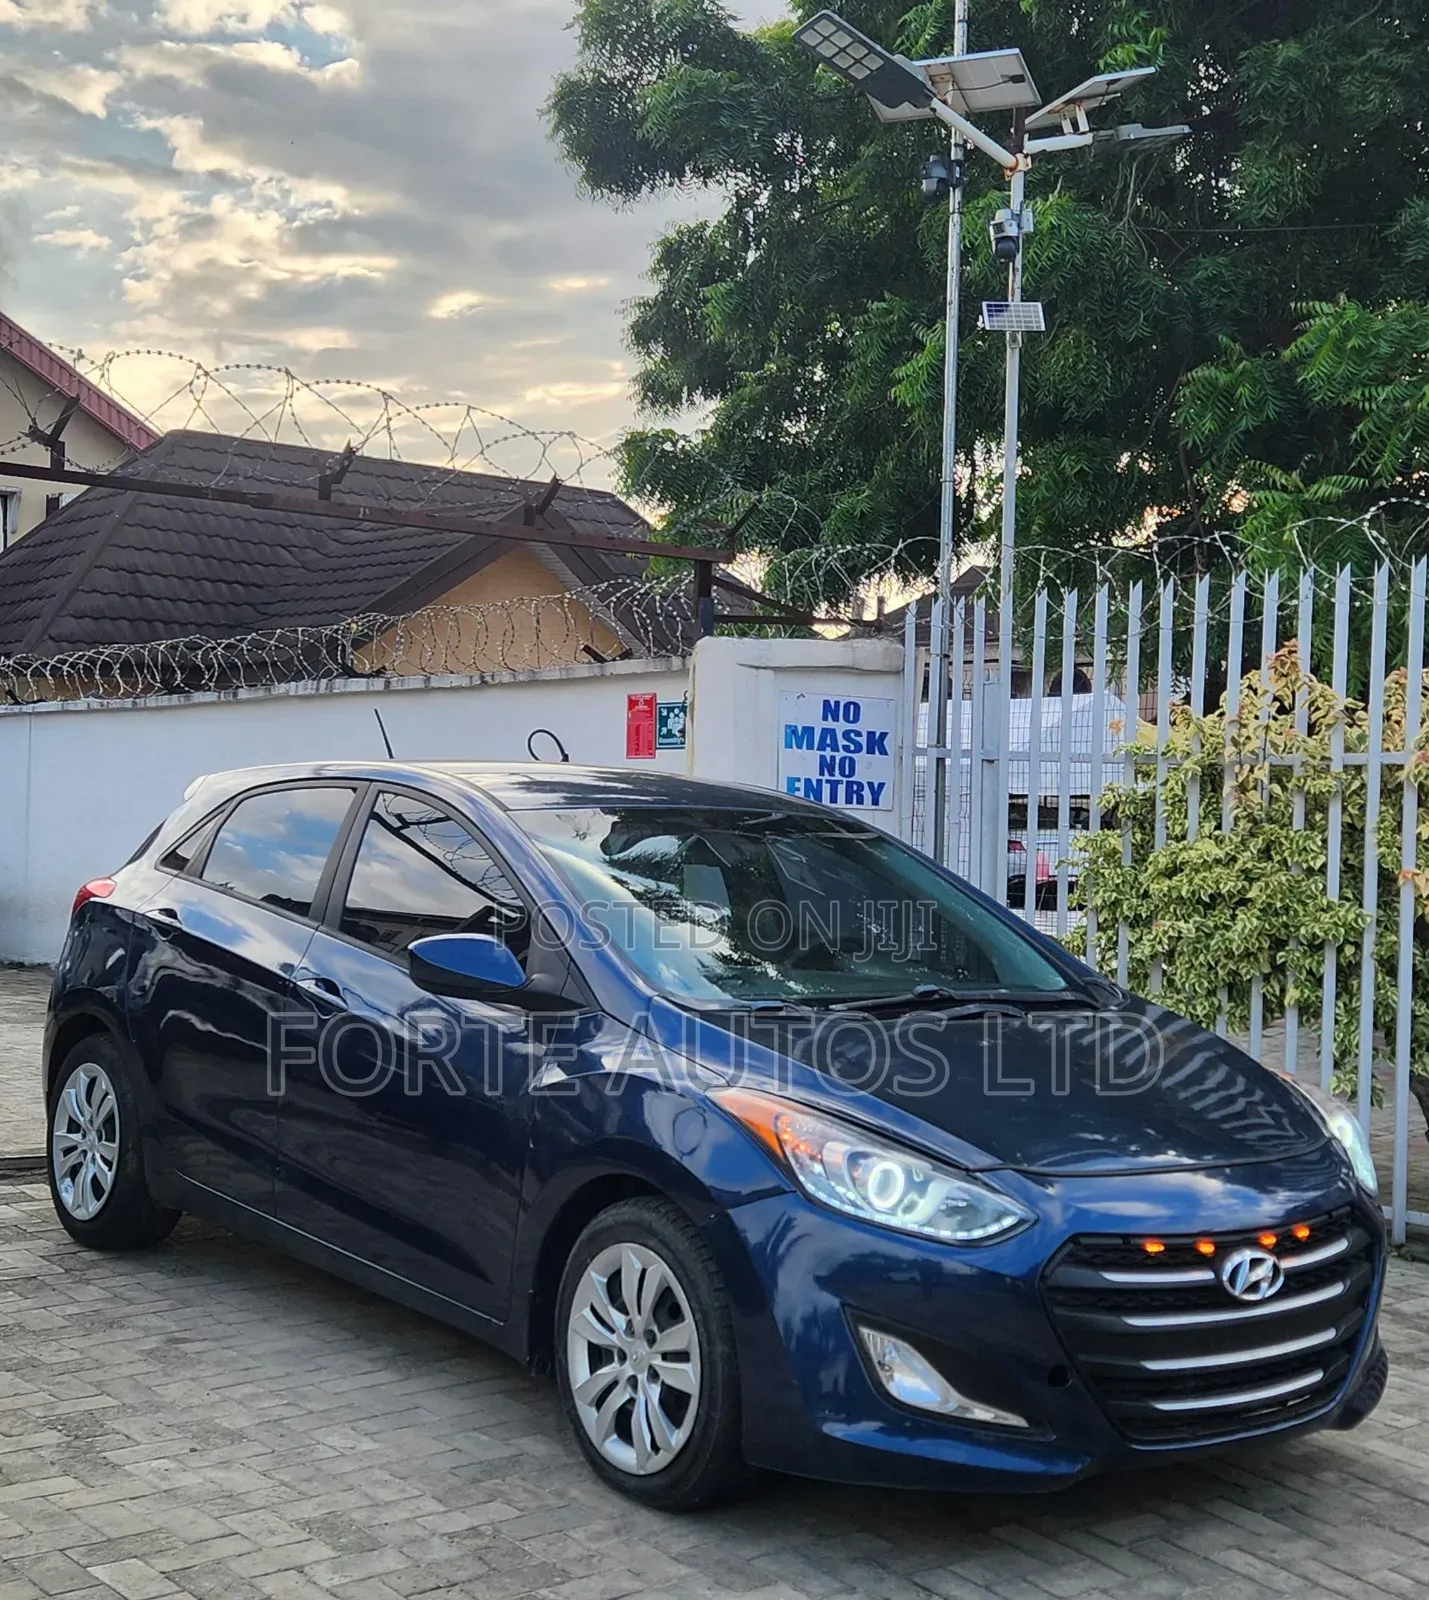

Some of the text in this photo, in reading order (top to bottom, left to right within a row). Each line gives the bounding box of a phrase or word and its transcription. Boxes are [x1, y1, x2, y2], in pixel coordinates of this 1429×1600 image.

[822, 699, 861, 724] NO
[785, 724, 889, 756] MASK
[818, 754, 856, 778] NO
[786, 776, 886, 806] ENTRY
